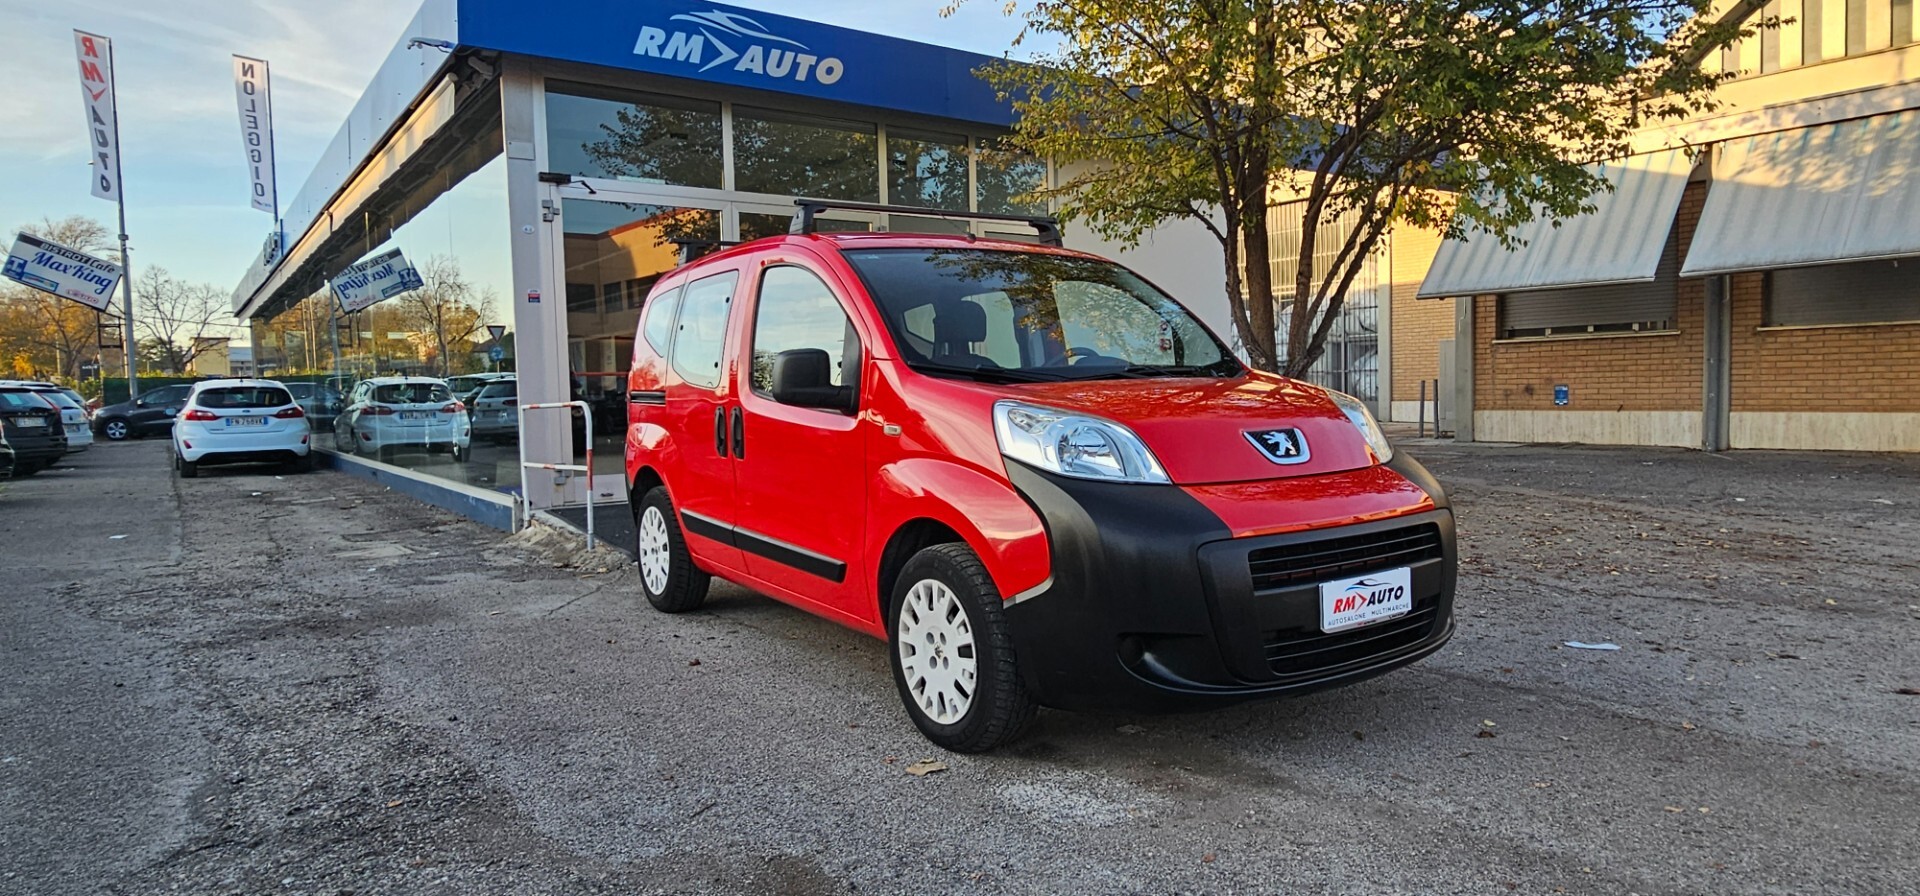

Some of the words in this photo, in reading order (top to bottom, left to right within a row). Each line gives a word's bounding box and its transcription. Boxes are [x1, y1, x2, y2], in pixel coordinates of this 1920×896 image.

[633, 26, 704, 64] RM
[734, 45, 844, 85] AUTO
[41, 243, 88, 264] BISTROT
[1333, 595, 1356, 614] RM
[1366, 585, 1404, 607] AUTO
[1328, 613, 1366, 626] AUTOSALONE
[1371, 603, 1409, 615] MULTIMARCHE
